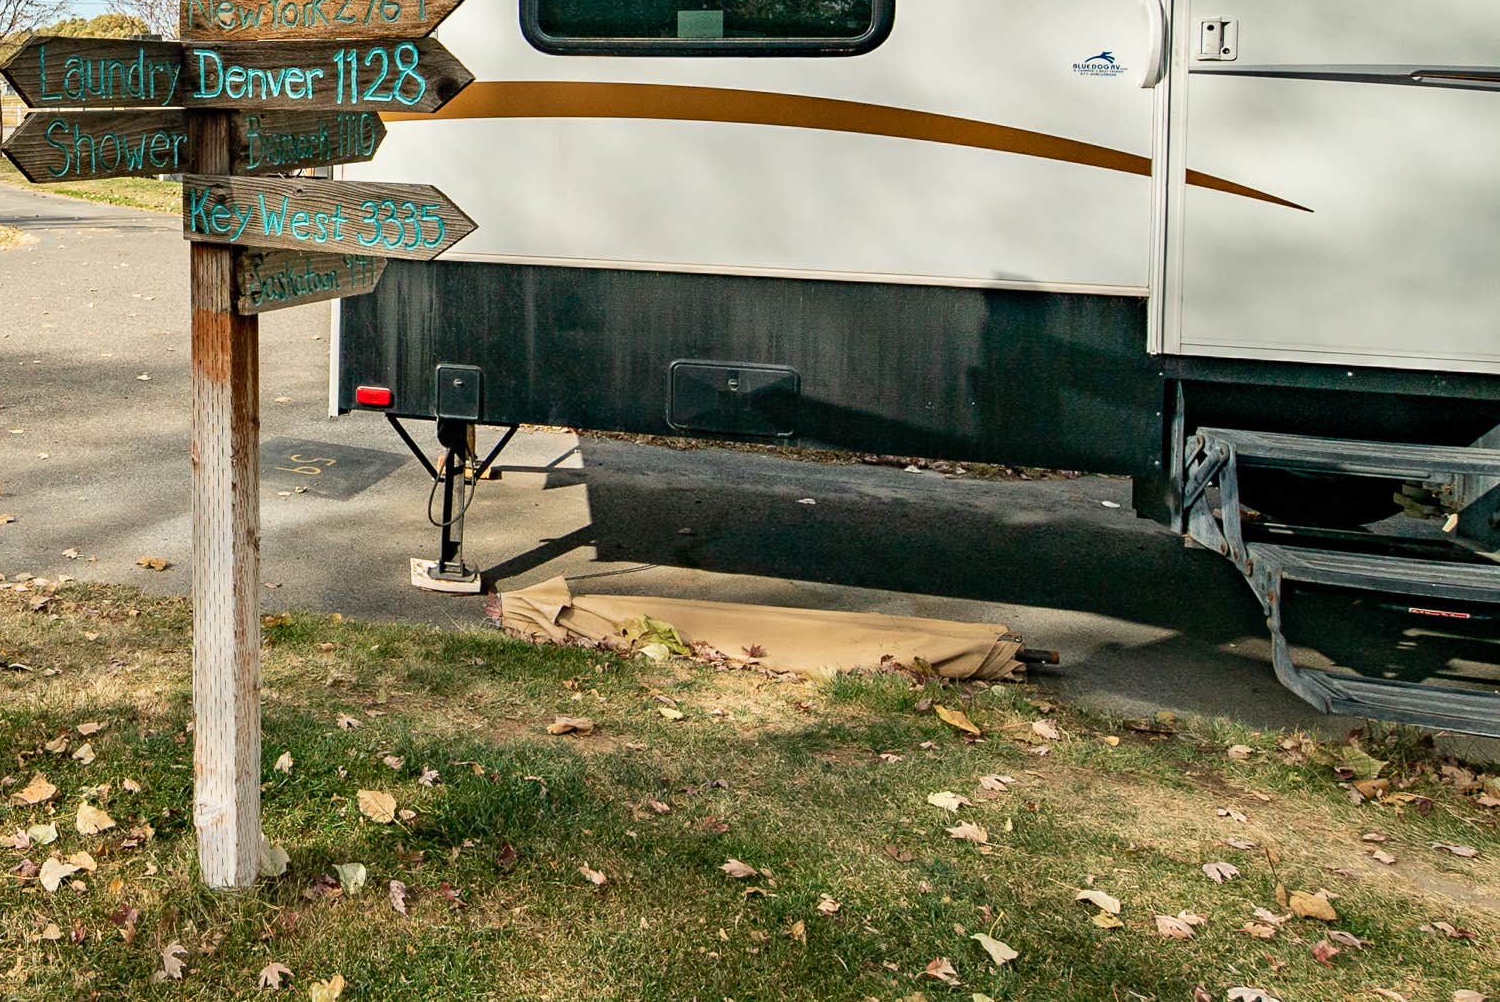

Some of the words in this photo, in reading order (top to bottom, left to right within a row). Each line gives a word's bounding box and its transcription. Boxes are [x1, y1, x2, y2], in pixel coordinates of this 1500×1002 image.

[39, 44, 182, 107] Laundry
[193, 48, 324, 100] Denver
[332, 41, 427, 106] 1128
[44, 118, 188, 178] Shower
[190, 187, 252, 243] Key
[258, 191, 349, 244] West
[356, 198, 446, 251] 3335
